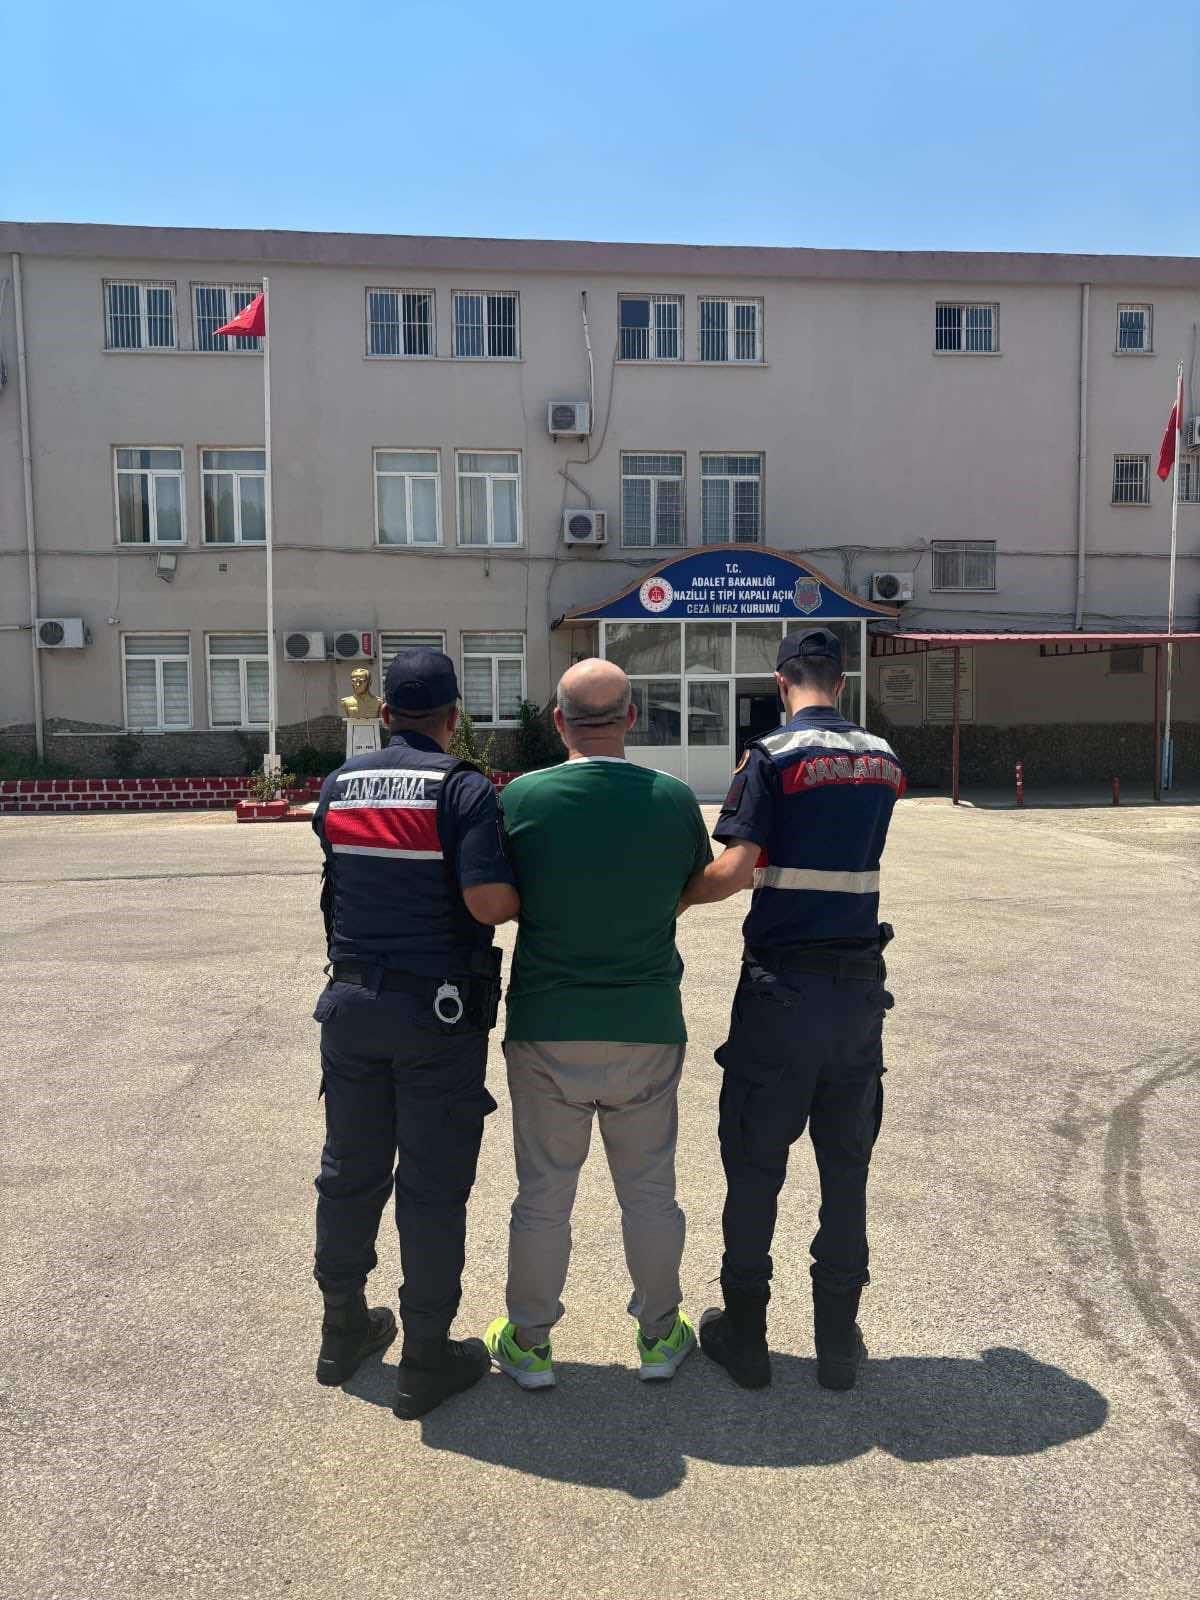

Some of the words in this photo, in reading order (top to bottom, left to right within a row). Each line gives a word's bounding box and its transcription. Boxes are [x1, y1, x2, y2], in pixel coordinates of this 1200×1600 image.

[725, 563, 742, 574] T.C.
[691, 577, 725, 587] ADALET
[728, 575, 776, 587] BAKANLIĞI
[673, 589, 708, 601] NAZİLLİ
[709, 591, 716, 601] E
[718, 589, 736, 600] TİPİ
[738, 591, 770, 600] KAPALI
[772, 590, 794, 602] AÇIK
[687, 604, 710, 614] CEZA
[712, 602, 738, 614] İNFAZ
[740, 604, 780, 614] KURUMU
[341, 777, 425, 800] JANDARMA
